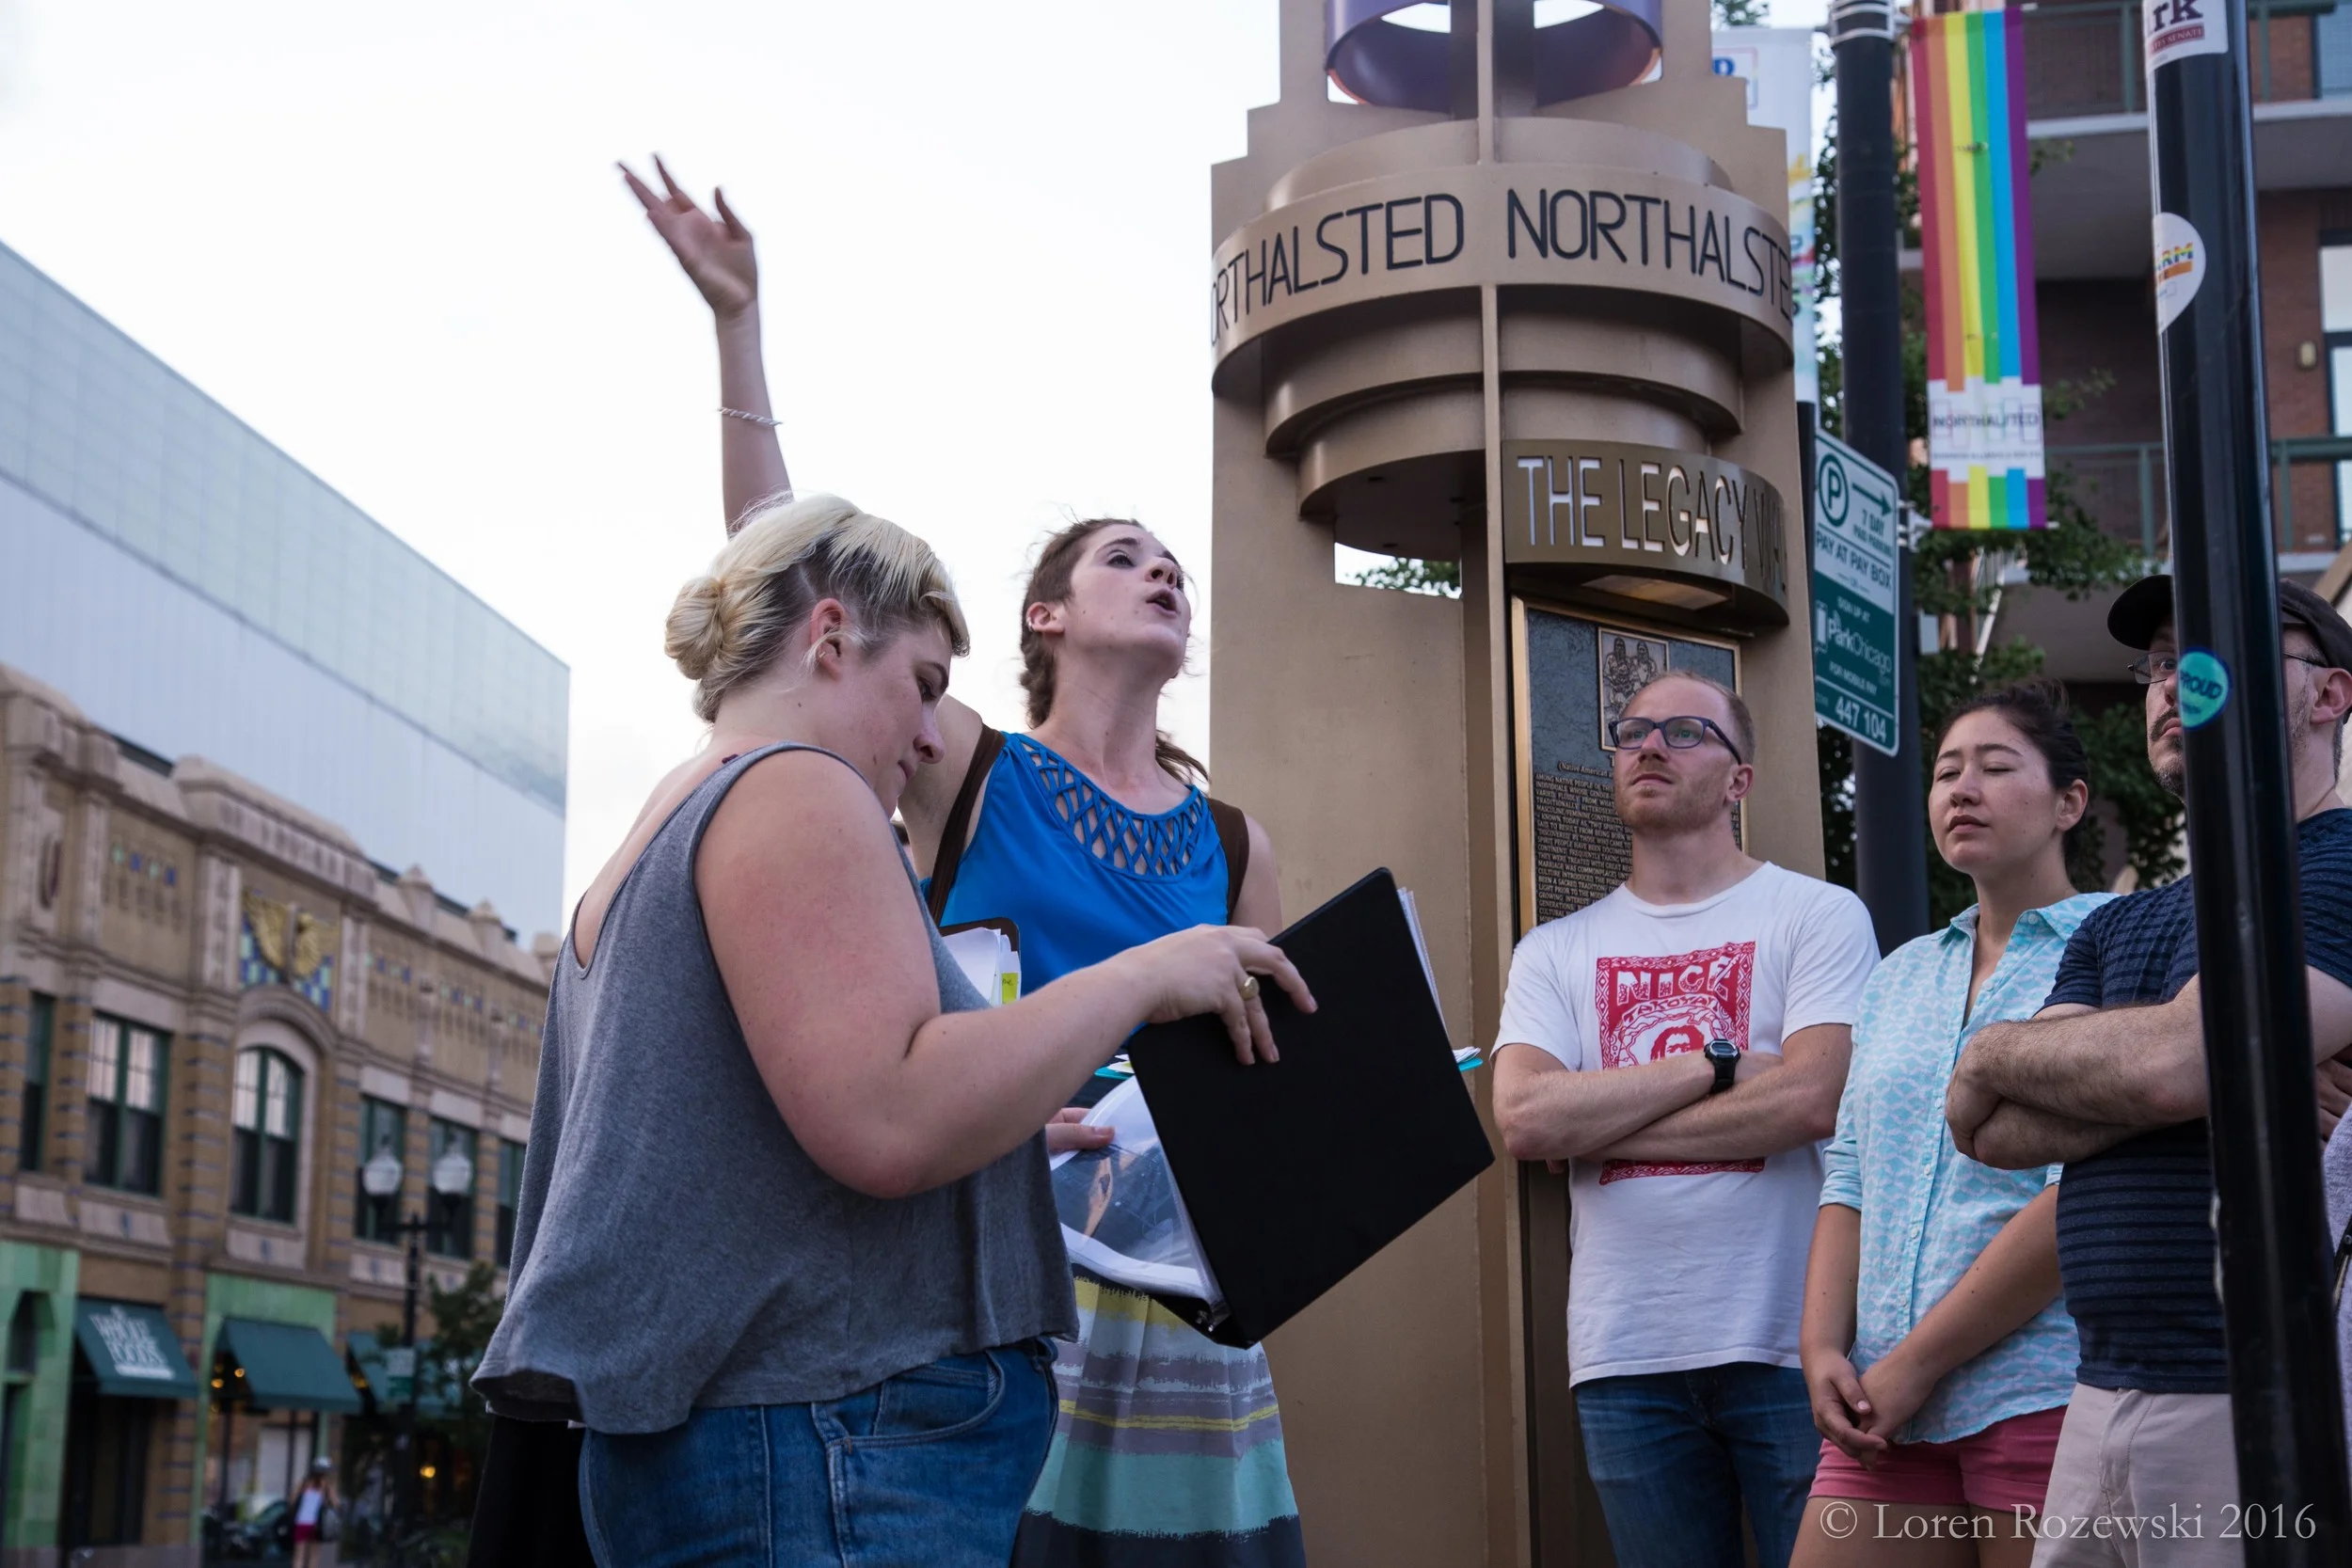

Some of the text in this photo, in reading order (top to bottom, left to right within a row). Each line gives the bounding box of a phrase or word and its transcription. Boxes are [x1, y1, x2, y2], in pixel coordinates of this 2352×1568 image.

[1211, 193, 1464, 346] ORTHALSTED
[1507, 188, 1793, 326] NORTHALSTE
[1517, 455, 1606, 546] THE
[1618, 458, 1749, 570] LEGACY
[1869, 513, 1884, 537] DAY
[1816, 530, 1892, 593] PAY AT PAY BOX
[1836, 696, 1887, 743] 447 104
[1554, 777, 1573, 785] NATIVE
[1575, 780, 1592, 788] PEOPLE
[1581, 765, 1607, 778] American
[1581, 796, 1597, 804] FROM
[1554, 839, 1572, 847] PEOPLE
[1610, 838, 1624, 847] CAME
[1616, 956, 1730, 1006] NICK
